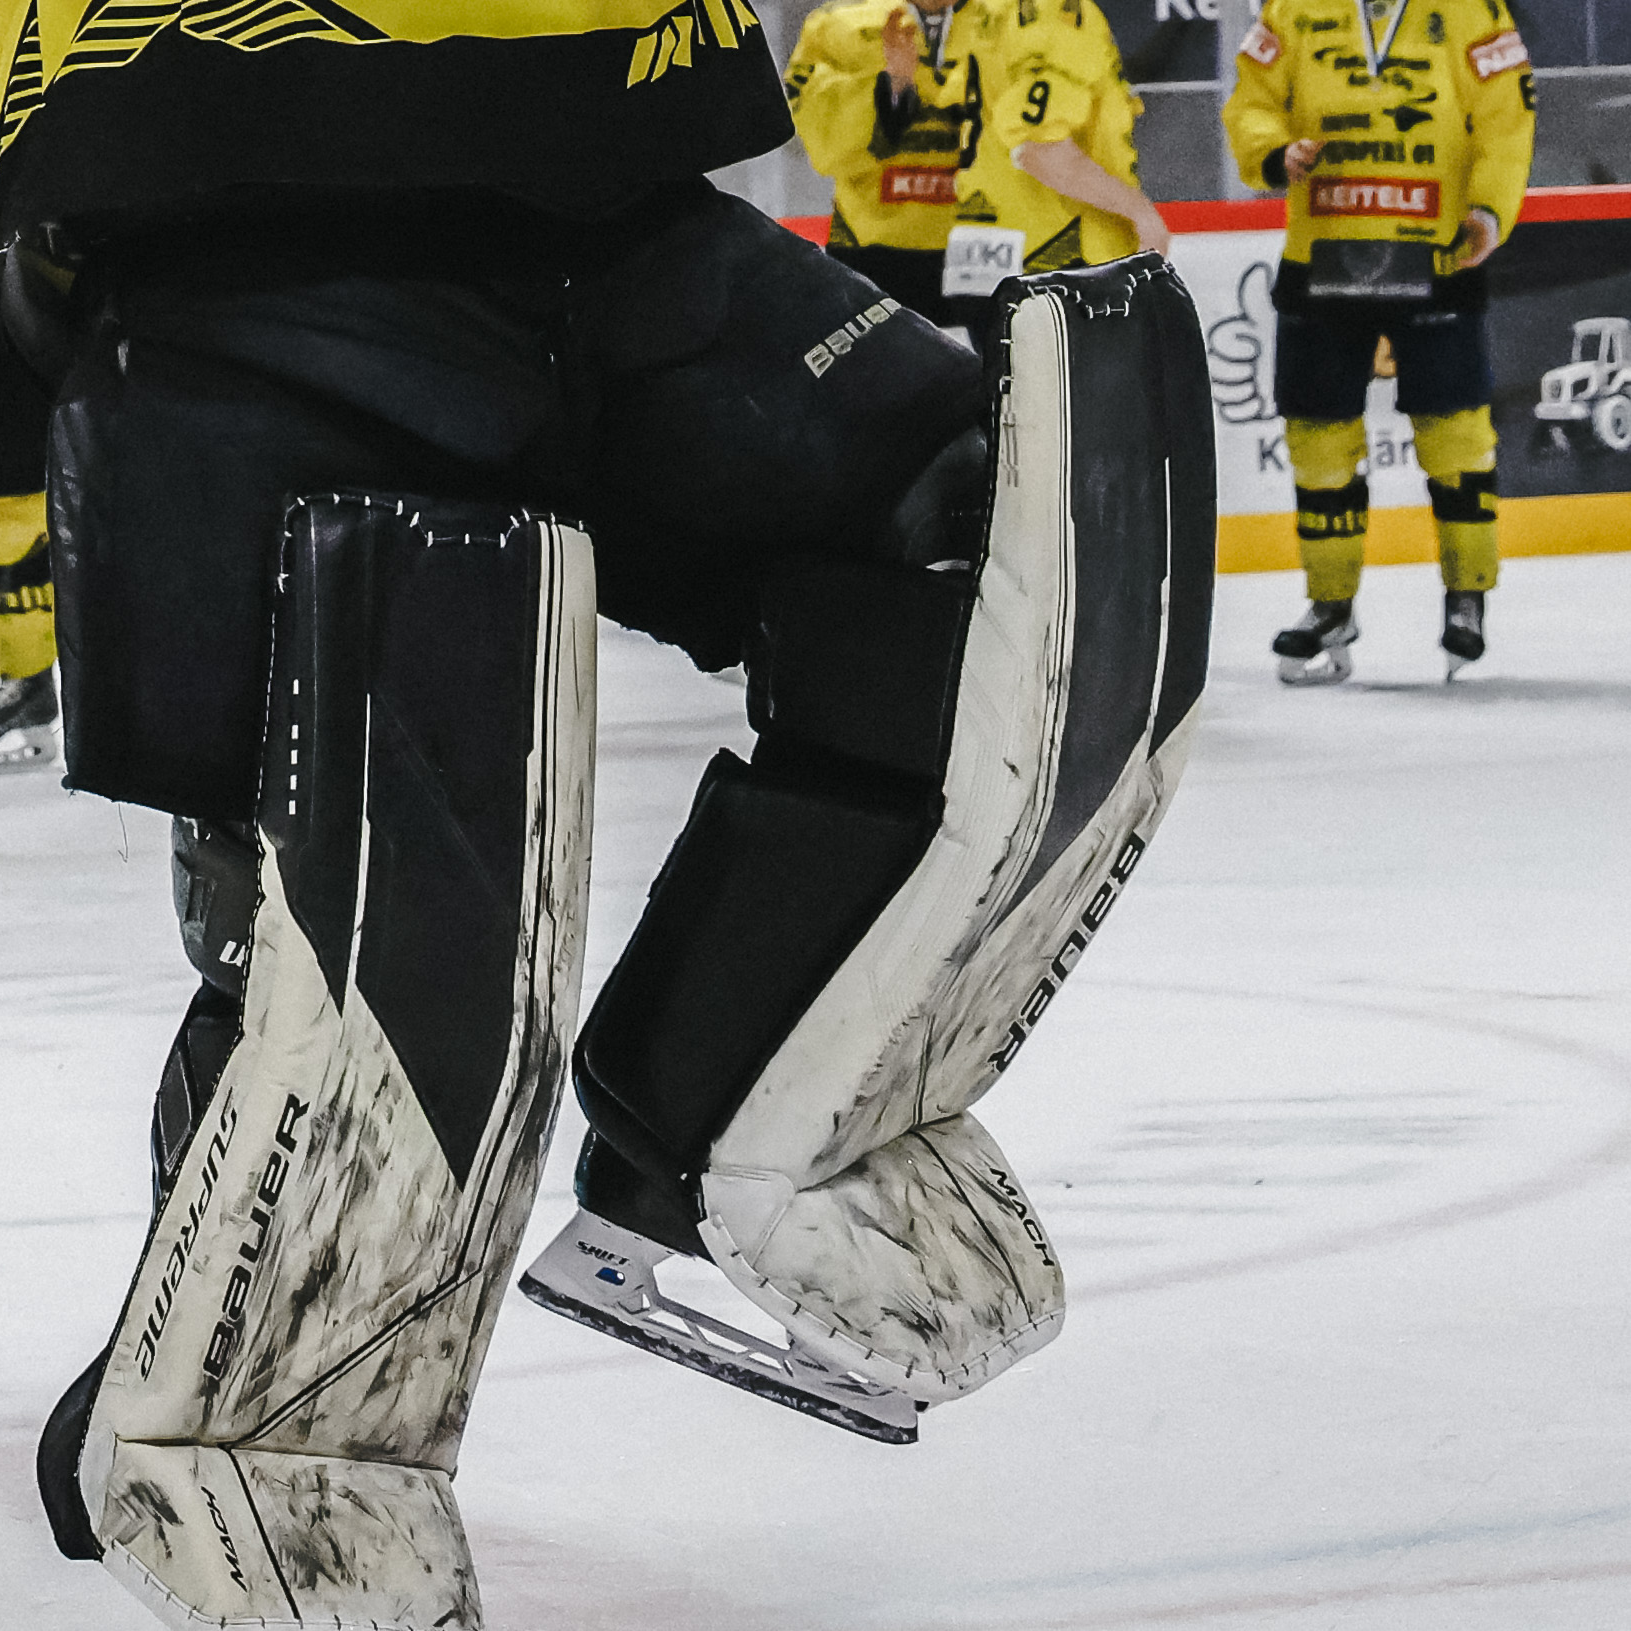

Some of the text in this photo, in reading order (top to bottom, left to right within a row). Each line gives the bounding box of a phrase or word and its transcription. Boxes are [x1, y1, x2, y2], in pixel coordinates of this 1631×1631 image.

[1022, 81, 1051, 124] 9
[990, 830, 1147, 1073] BAUER
[134, 1085, 238, 1383] SUPREME
[201, 1090, 312, 1381] BAUER
[989, 1167, 1056, 1269] MACH
[199, 1484, 248, 1594] MACH
